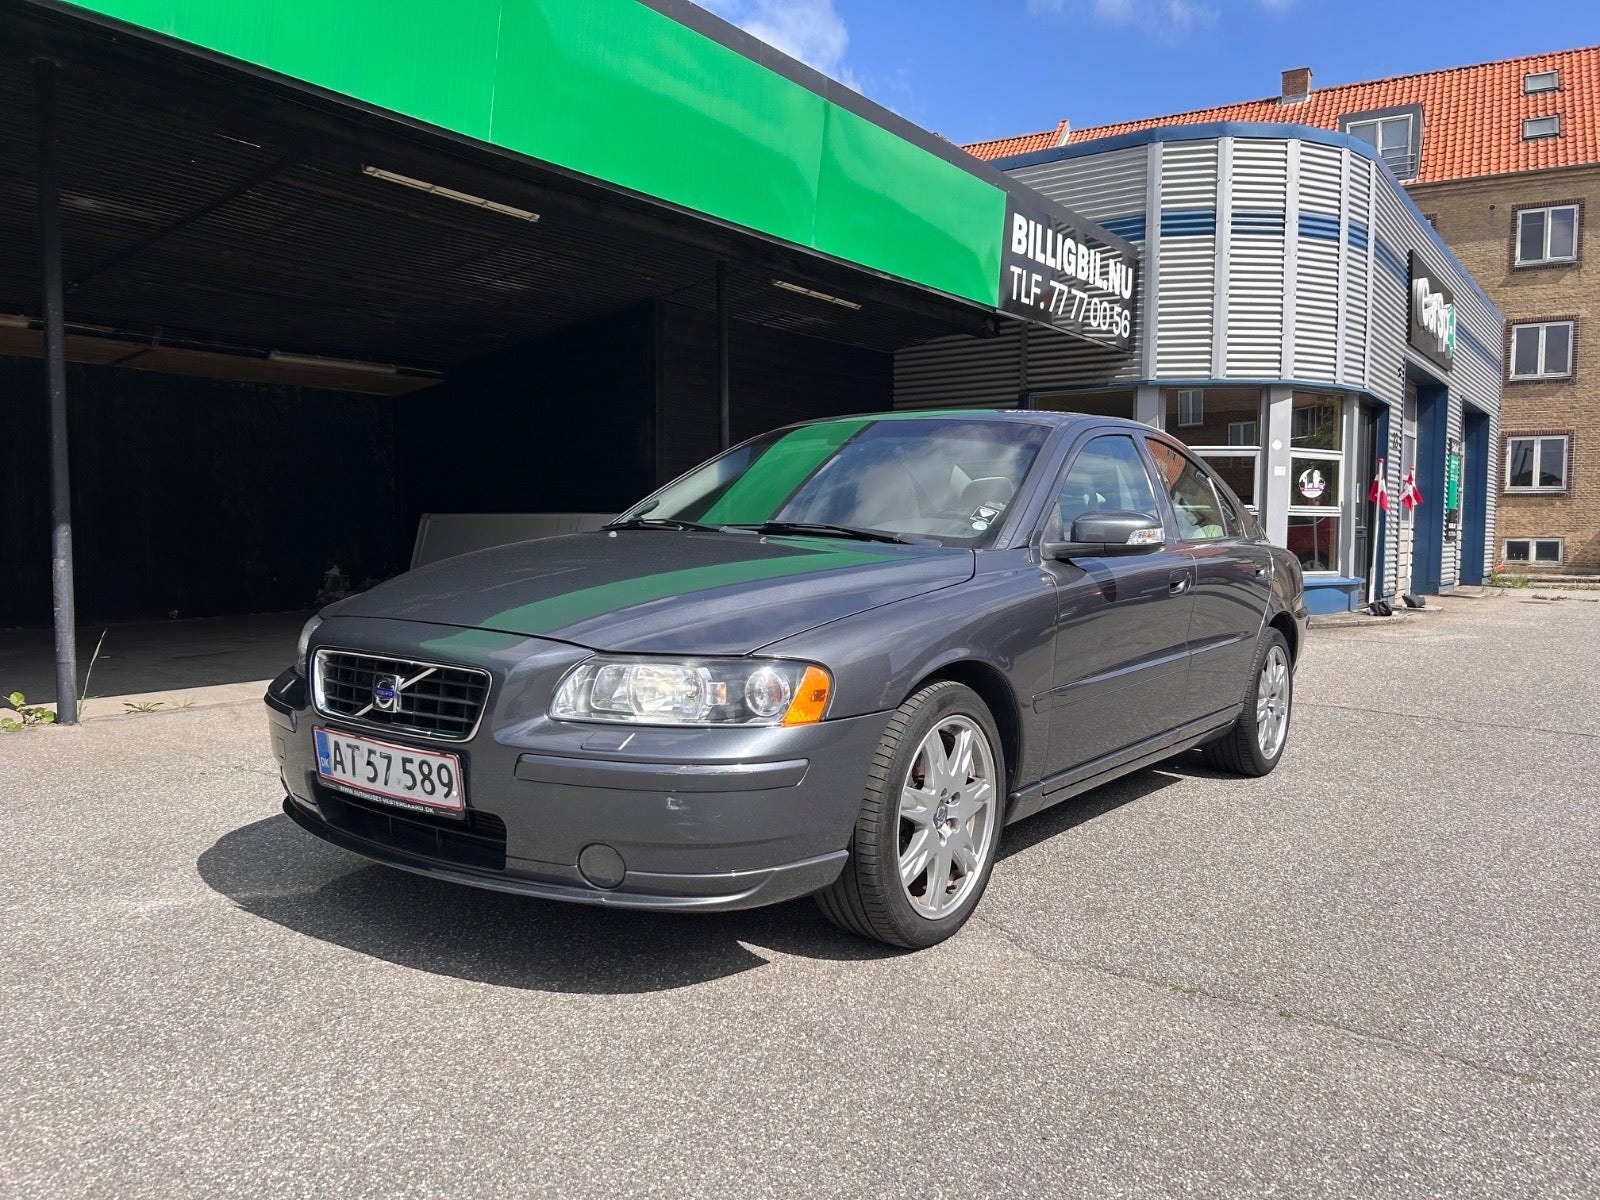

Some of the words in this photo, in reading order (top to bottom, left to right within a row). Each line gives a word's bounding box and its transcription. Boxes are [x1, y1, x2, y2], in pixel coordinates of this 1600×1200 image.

[1011, 212, 1133, 300] BILLIGBIL.NU
[1010, 265, 1045, 310] TLF.
[1112, 306, 1131, 338] 56
[320, 756, 330, 769] DK
[333, 740, 360, 777] AT
[366, 748, 393, 786] 57
[401, 756, 454, 799] 589
